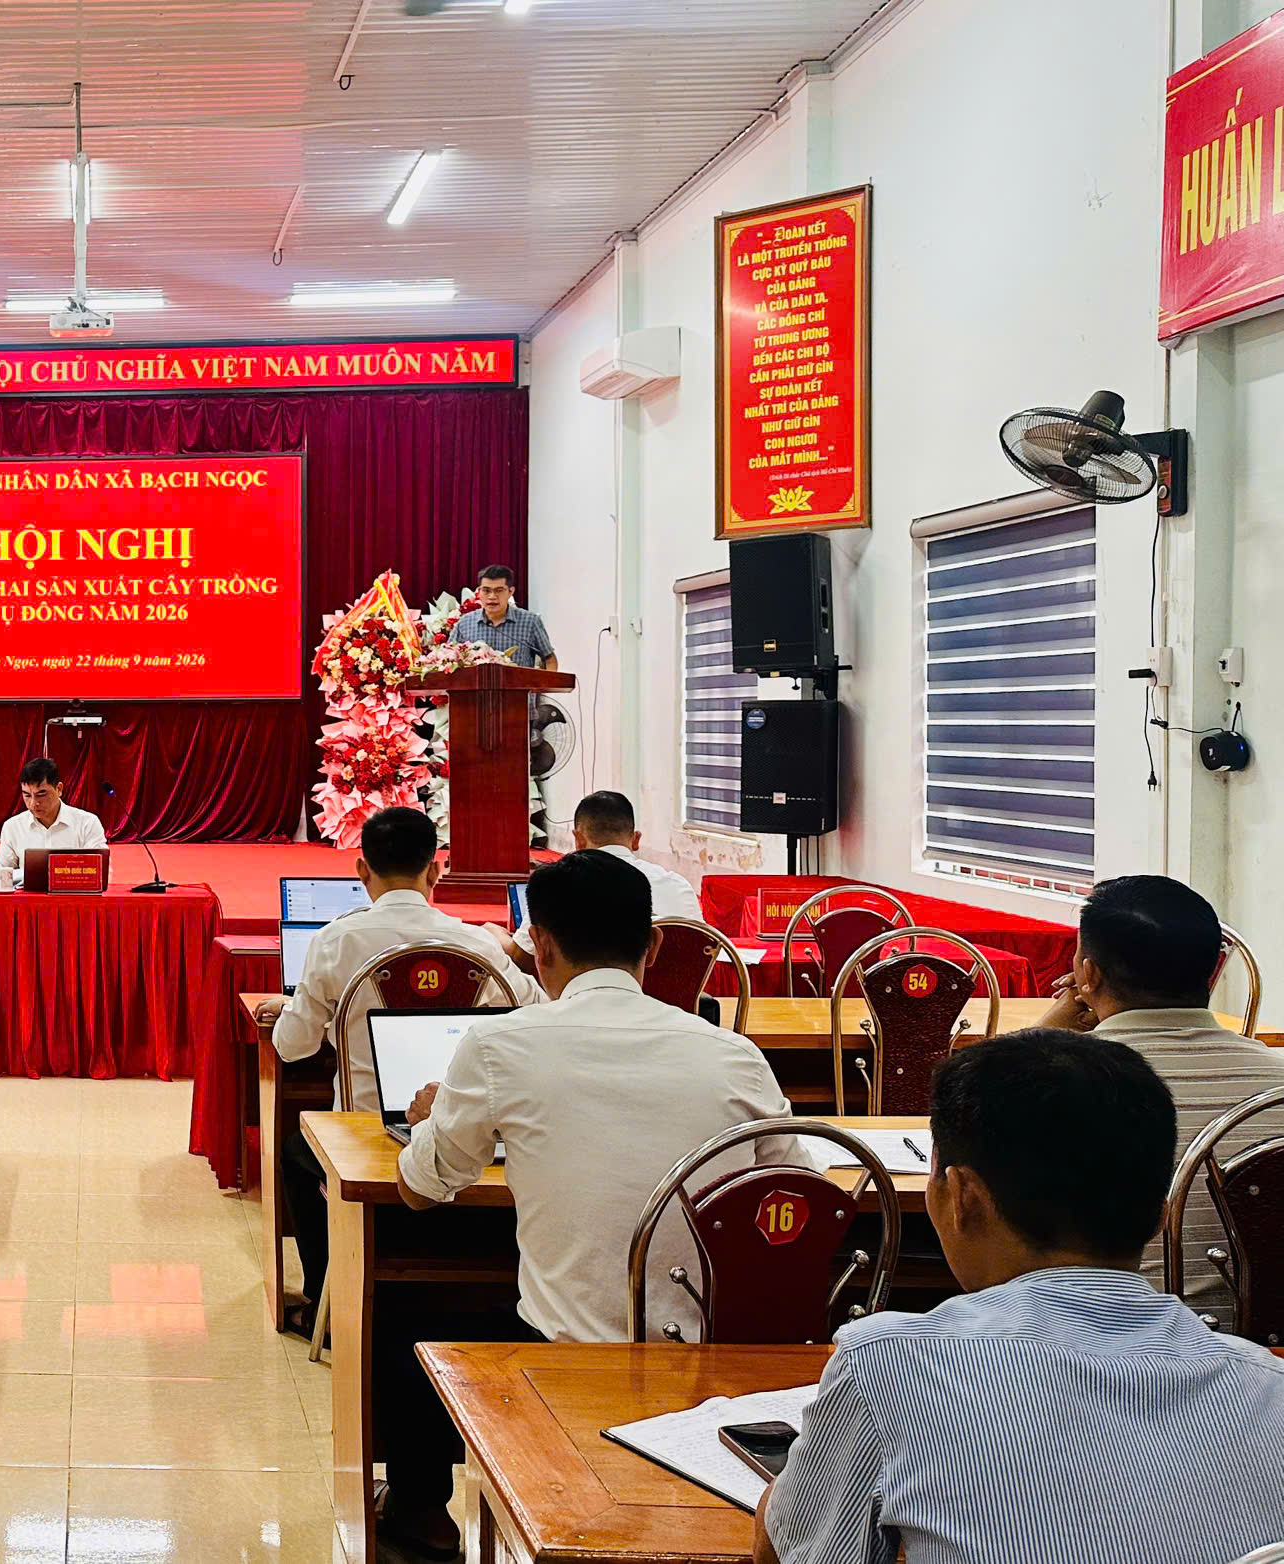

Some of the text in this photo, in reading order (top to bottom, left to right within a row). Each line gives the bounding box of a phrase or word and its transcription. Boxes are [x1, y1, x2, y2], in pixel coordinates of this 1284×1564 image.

[1180, 88, 1263, 256] HUẤN
[808, 220, 826, 235] KẾT
[738, 253, 749, 267] LÀ
[752, 249, 772, 264] MỘT
[814, 234, 847, 251] THỐNG
[752, 267, 772, 281] CỰC
[774, 262, 786, 276] KỲ
[811, 255, 831, 270] BÁU
[767, 276, 815, 295] CỦA ĐẢNG
[754, 301, 767, 313] VÀ
[770, 296, 789, 312] CỦA
[791, 294, 812, 308] DÂN
[757, 317, 776, 331] CÁC
[808, 307, 825, 322] CHÍ
[768, 332, 799, 347] TRUNG
[802, 326, 829, 341] ƯƠNG
[753, 342, 830, 366] ĐẾN CÁC CHI BỘ
[31, 354, 88, 382] CHỦ
[96, 354, 185, 380] NGHĨA
[190, 355, 257, 383] VIỆT
[265, 355, 328, 377] NAM
[336, 348, 421, 376] MUÔN
[430, 348, 496, 374] NĂM
[772, 364, 794, 380] PHẢI
[797, 362, 814, 376] GIỮ
[816, 360, 833, 374] GÌN
[760, 377, 822, 400] SỰ ĐOÀN KẾT
[745, 394, 839, 418] NHẤT TRÍ CỦA ĐẢNG
[762, 414, 820, 433] NHƯ GIỮ GÌN
[765, 437, 785, 450] CON
[749, 454, 768, 469] CỦA
[770, 451, 791, 466] MẮT
[55, 469, 98, 489] DÂN
[105, 470, 134, 488] XÃ
[141, 471, 199, 492] BẠCH
[205, 470, 267, 490] NGỌC
[76, 528, 193, 568] NGHỊ
[36, 576, 76, 596] SẢN
[84, 573, 143, 596] XUẤT
[148, 575, 194, 595] CÂY
[199, 572, 277, 594] TRỒNG
[21, 601, 83, 621] ĐÔNG
[89, 602, 139, 621] NĂM
[146, 604, 188, 620] 2026
[5, 656, 39, 669] Ngọc,
[42, 657, 72, 669] ngày
[76, 655, 91, 666] 22
[94, 655, 130, 669] tháng
[134, 655, 141, 665] 9
[144, 656, 171, 666] năm
[175, 654, 205, 665] 2026
[766, 902, 779, 920] HỘI
[417, 970, 438, 989] 29
[908, 973, 928, 990] 54
[766, 1202, 794, 1232] 16
